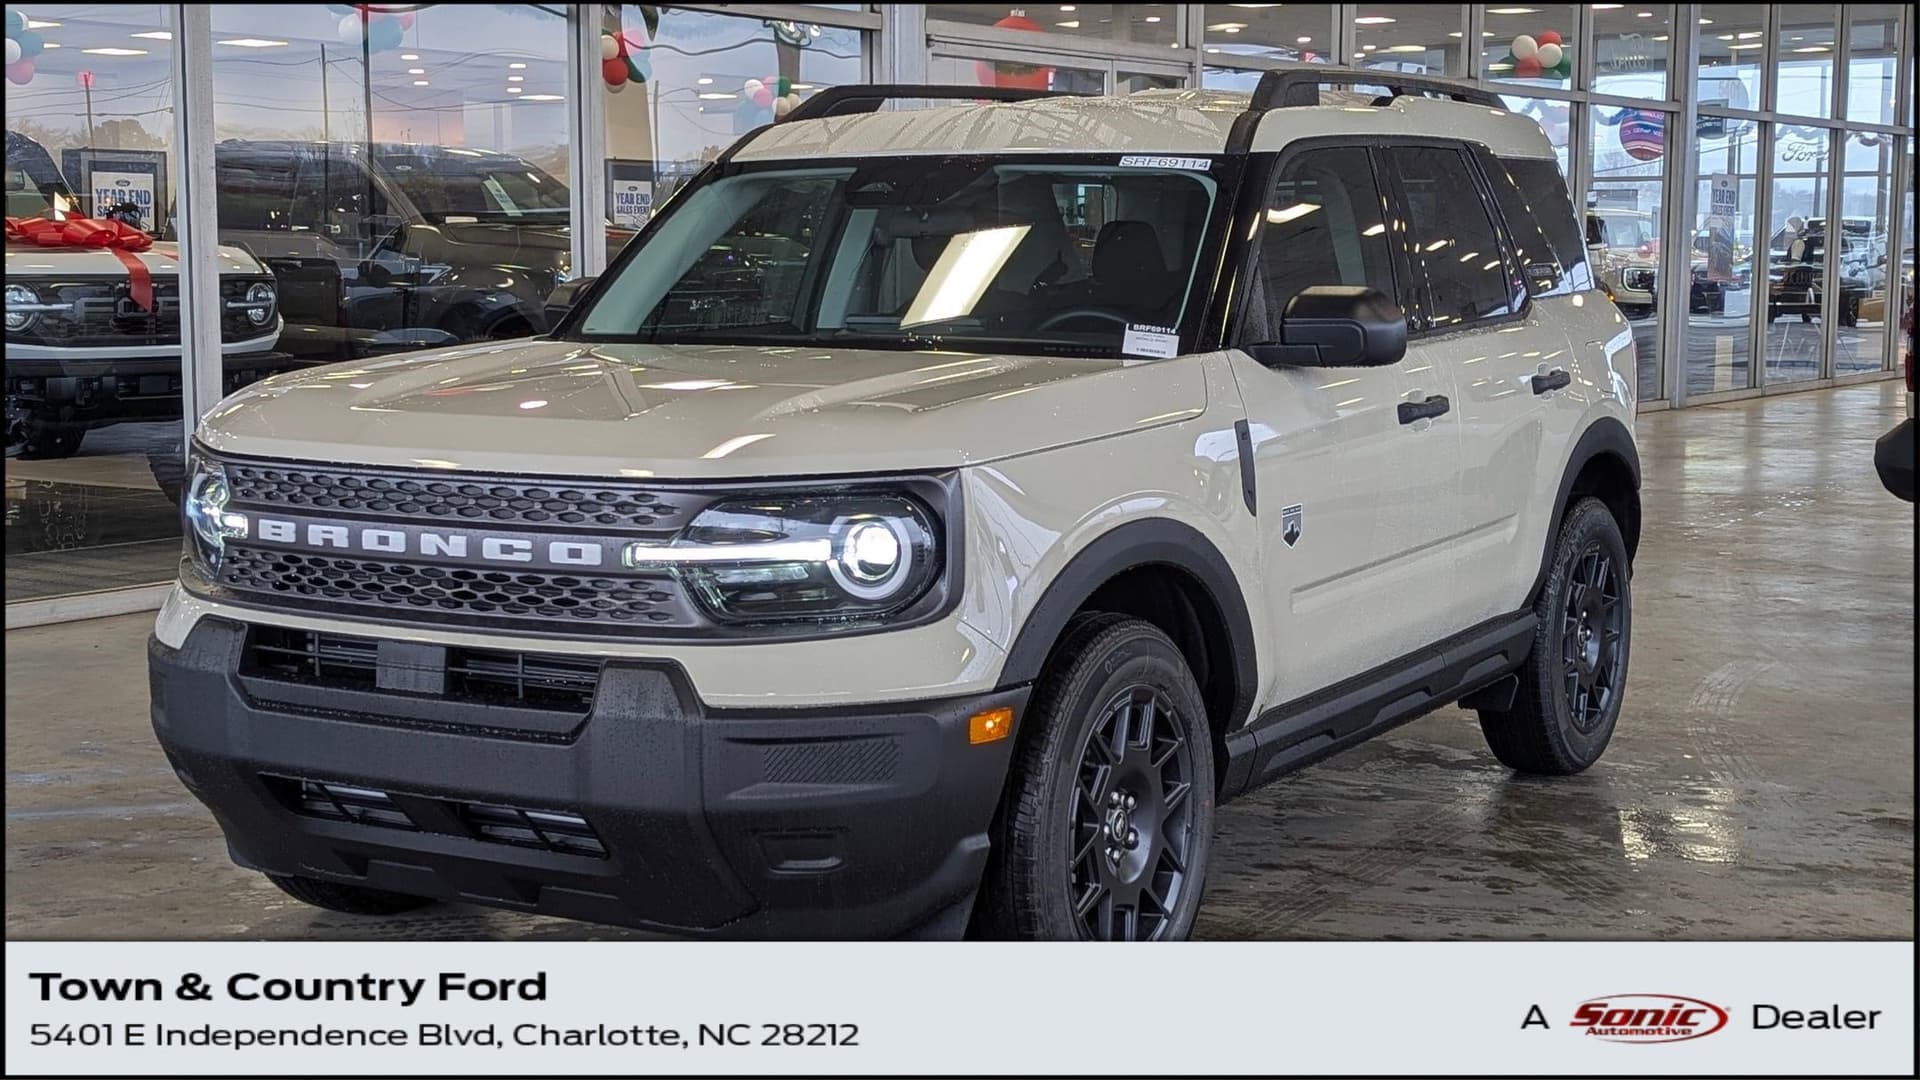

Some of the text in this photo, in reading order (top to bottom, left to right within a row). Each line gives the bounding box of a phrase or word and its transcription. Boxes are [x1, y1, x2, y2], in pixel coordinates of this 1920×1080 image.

[1121, 156, 1209, 170] SRF69114
[95, 188, 152, 205] YEAR END
[616, 192, 650, 205] YEAR END
[616, 205, 633, 215] SALES
[258, 518, 602, 565] BRONCO
